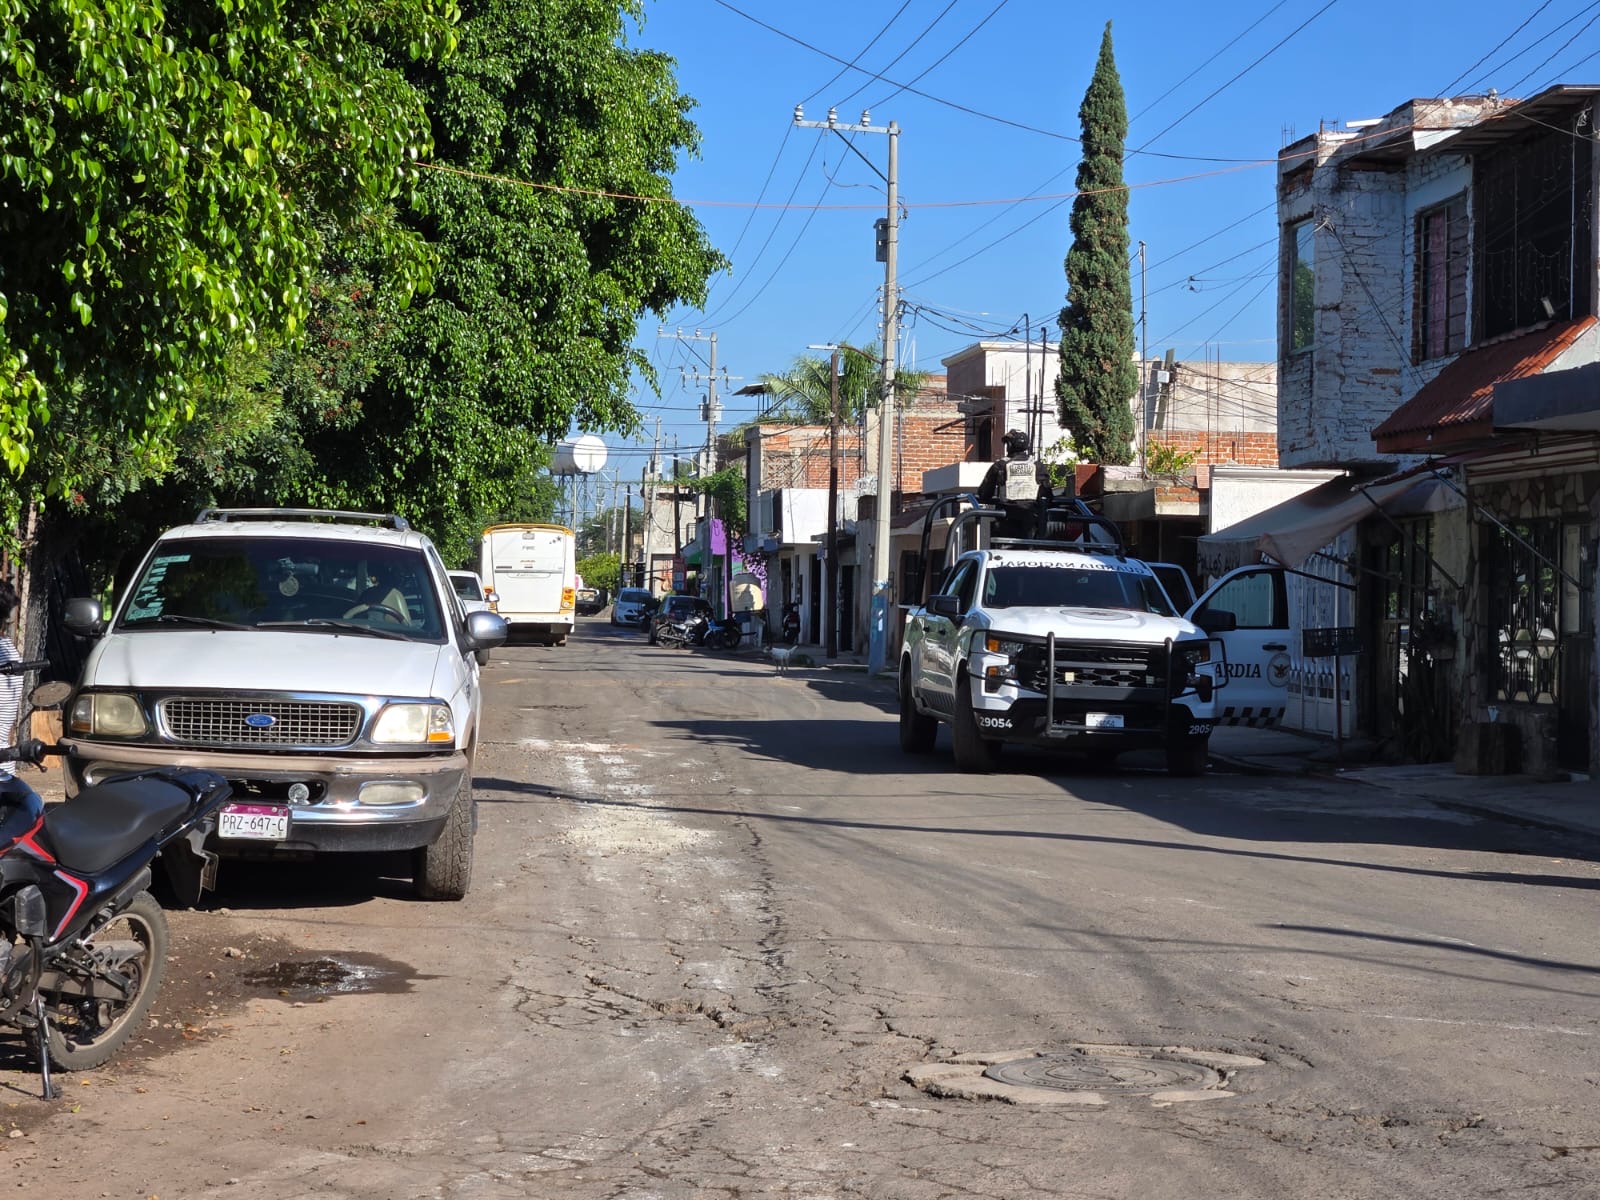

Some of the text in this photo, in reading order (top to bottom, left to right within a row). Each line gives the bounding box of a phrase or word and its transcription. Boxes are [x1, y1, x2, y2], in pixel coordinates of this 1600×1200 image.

[1215, 663, 1261, 678] ARDIA
[979, 716, 1013, 729] 29054
[1188, 724, 1212, 735] 2905
[223, 815, 285, 832] PRZ-647-C
